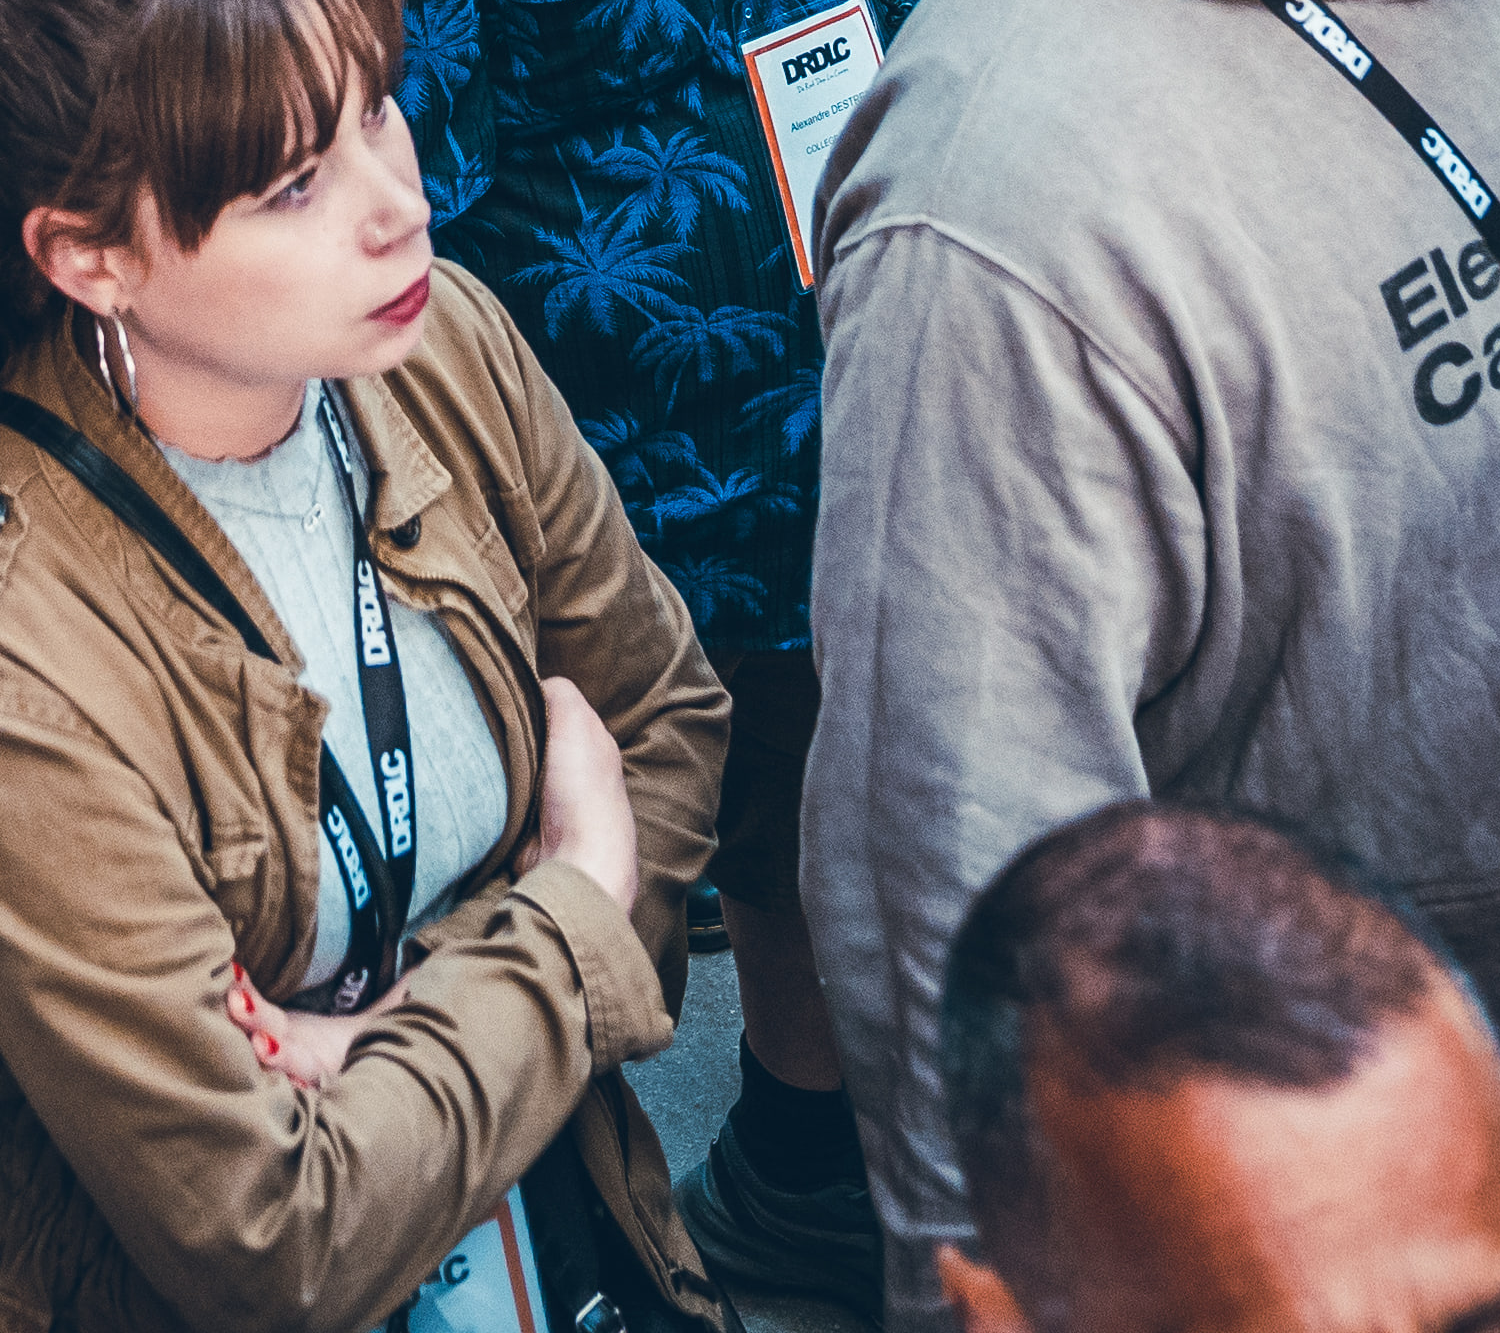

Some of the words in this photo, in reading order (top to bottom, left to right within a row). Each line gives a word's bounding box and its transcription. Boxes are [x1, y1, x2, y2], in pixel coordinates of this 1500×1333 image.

[782, 36, 851, 86] DRDLC
[790, 106, 831, 134] Alexandre
[1421, 127, 1492, 219] DRDLC
[356, 558, 391, 668] DRDLC
[383, 747, 415, 859] DRDLC
[326, 803, 370, 910] DRDLC
